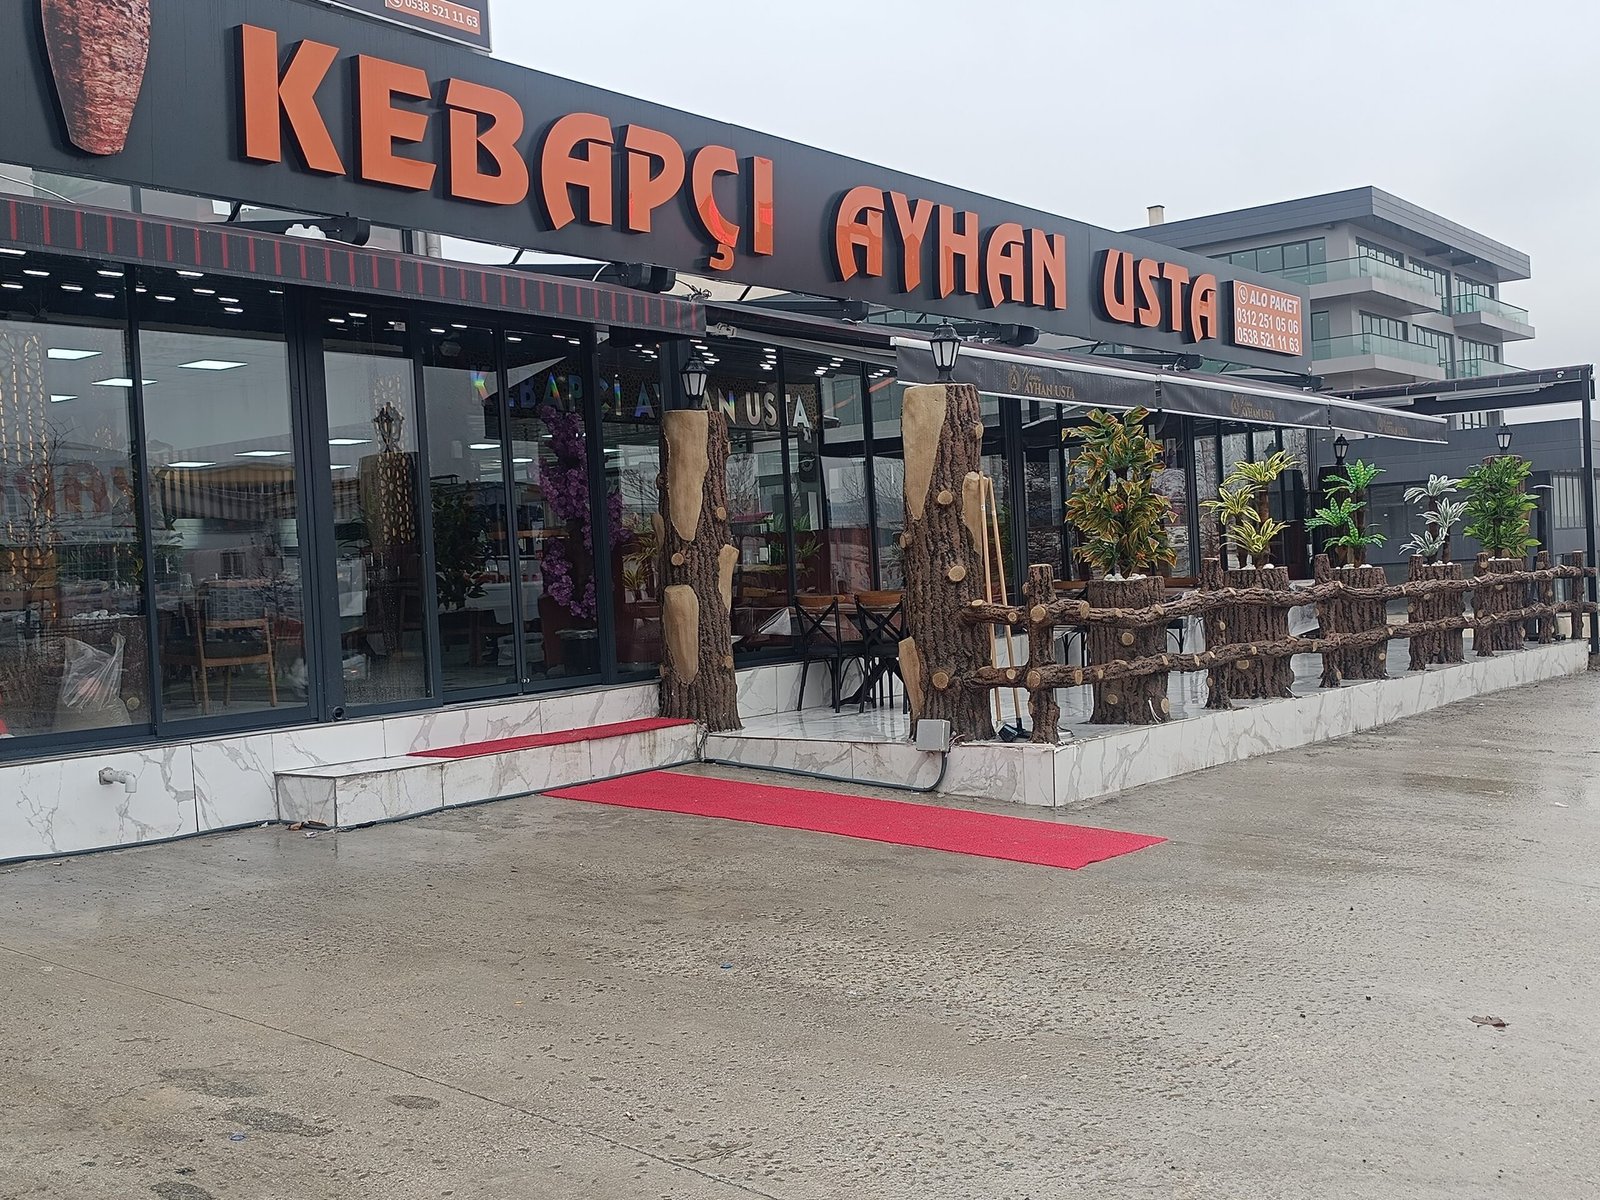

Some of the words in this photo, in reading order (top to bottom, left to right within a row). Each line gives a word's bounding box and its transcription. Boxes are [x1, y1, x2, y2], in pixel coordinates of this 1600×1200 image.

[405, 0, 430, 13] 0538
[432, 6, 450, 19] 521
[452, 11, 464, 24] 11
[466, 14, 478, 28] 63
[238, 23, 774, 270] KEBAPÇI
[834, 185, 1067, 310] AYHAN
[1101, 248, 1217, 342] USTA
[1249, 290, 1268, 308] ALO
[1269, 294, 1298, 314] PAKET
[1236, 307, 1257, 326] 0312
[1259, 312, 1273, 330] 251
[1275, 316, 1286, 332] 05
[1288, 320, 1299, 334] 06
[1237, 327, 1259, 345] 0538
[1260, 331, 1275, 348] 521
[1277, 335, 1287, 350] 11
[1289, 337, 1299, 352] 63
[1024, 382, 1053, 396] AYHAN
[1055, 385, 1075, 399] USTA
